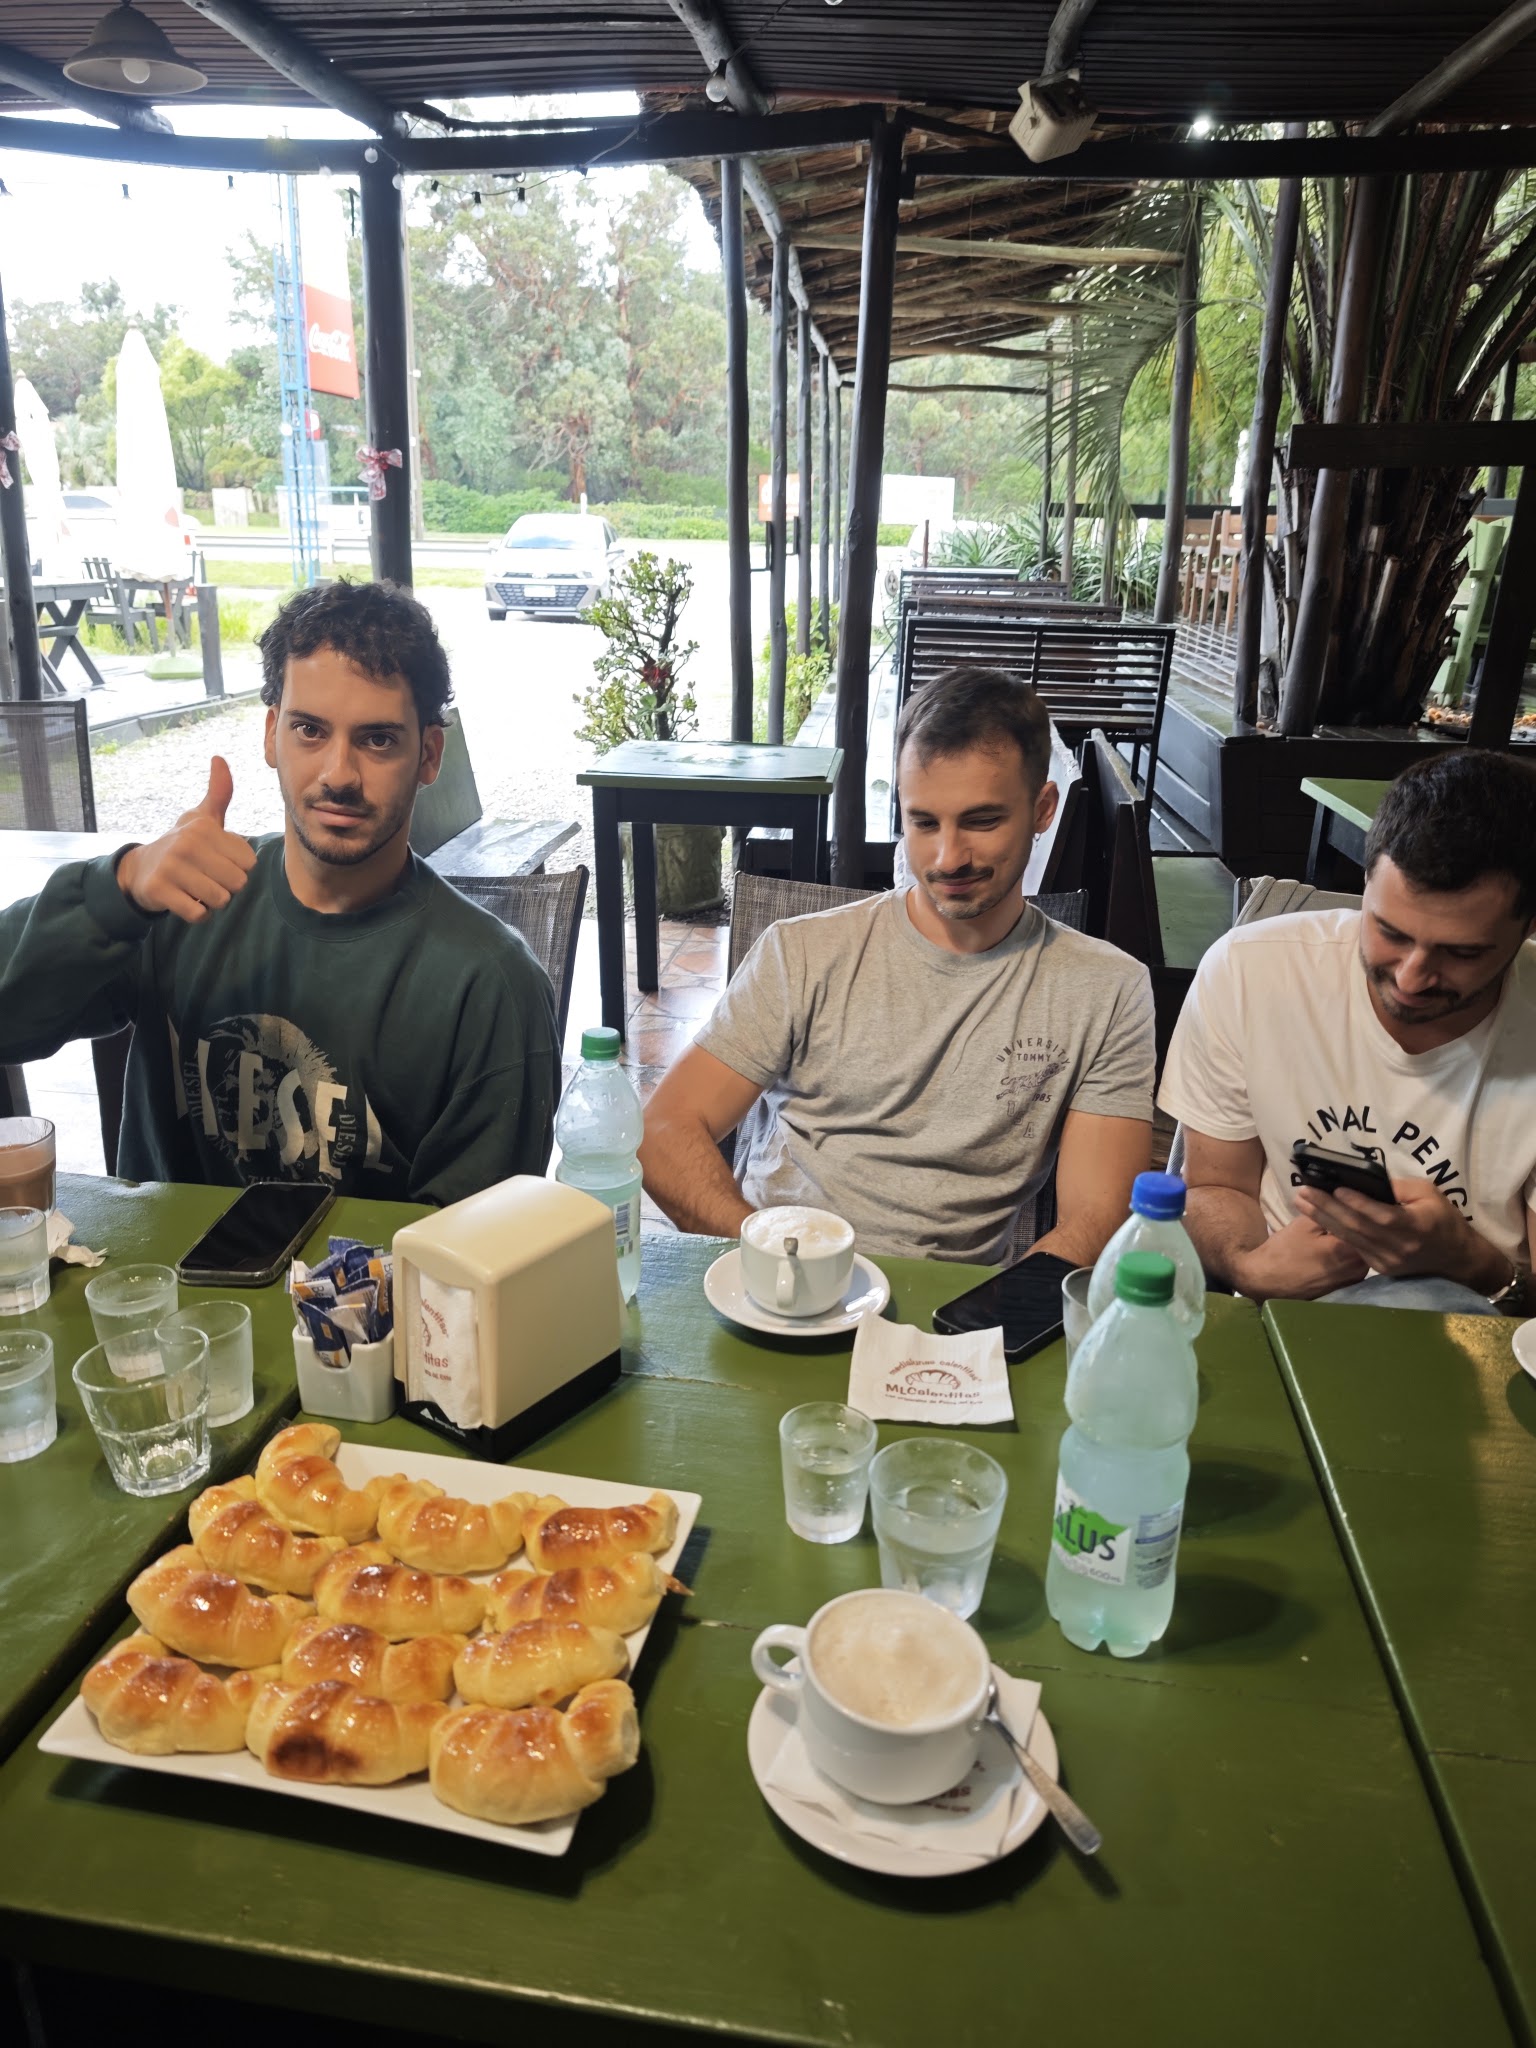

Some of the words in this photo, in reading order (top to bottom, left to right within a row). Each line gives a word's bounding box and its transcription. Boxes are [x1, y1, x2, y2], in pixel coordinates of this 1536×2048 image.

[996, 1037, 1071, 1065] UNIVERSITY
[1016, 1053, 1052, 1062] TOMMY
[1031, 1093, 1053, 1103] 1985
[1392, 1120, 1474, 1222] PENG
[1055, 1503, 1116, 1562] ALUS
